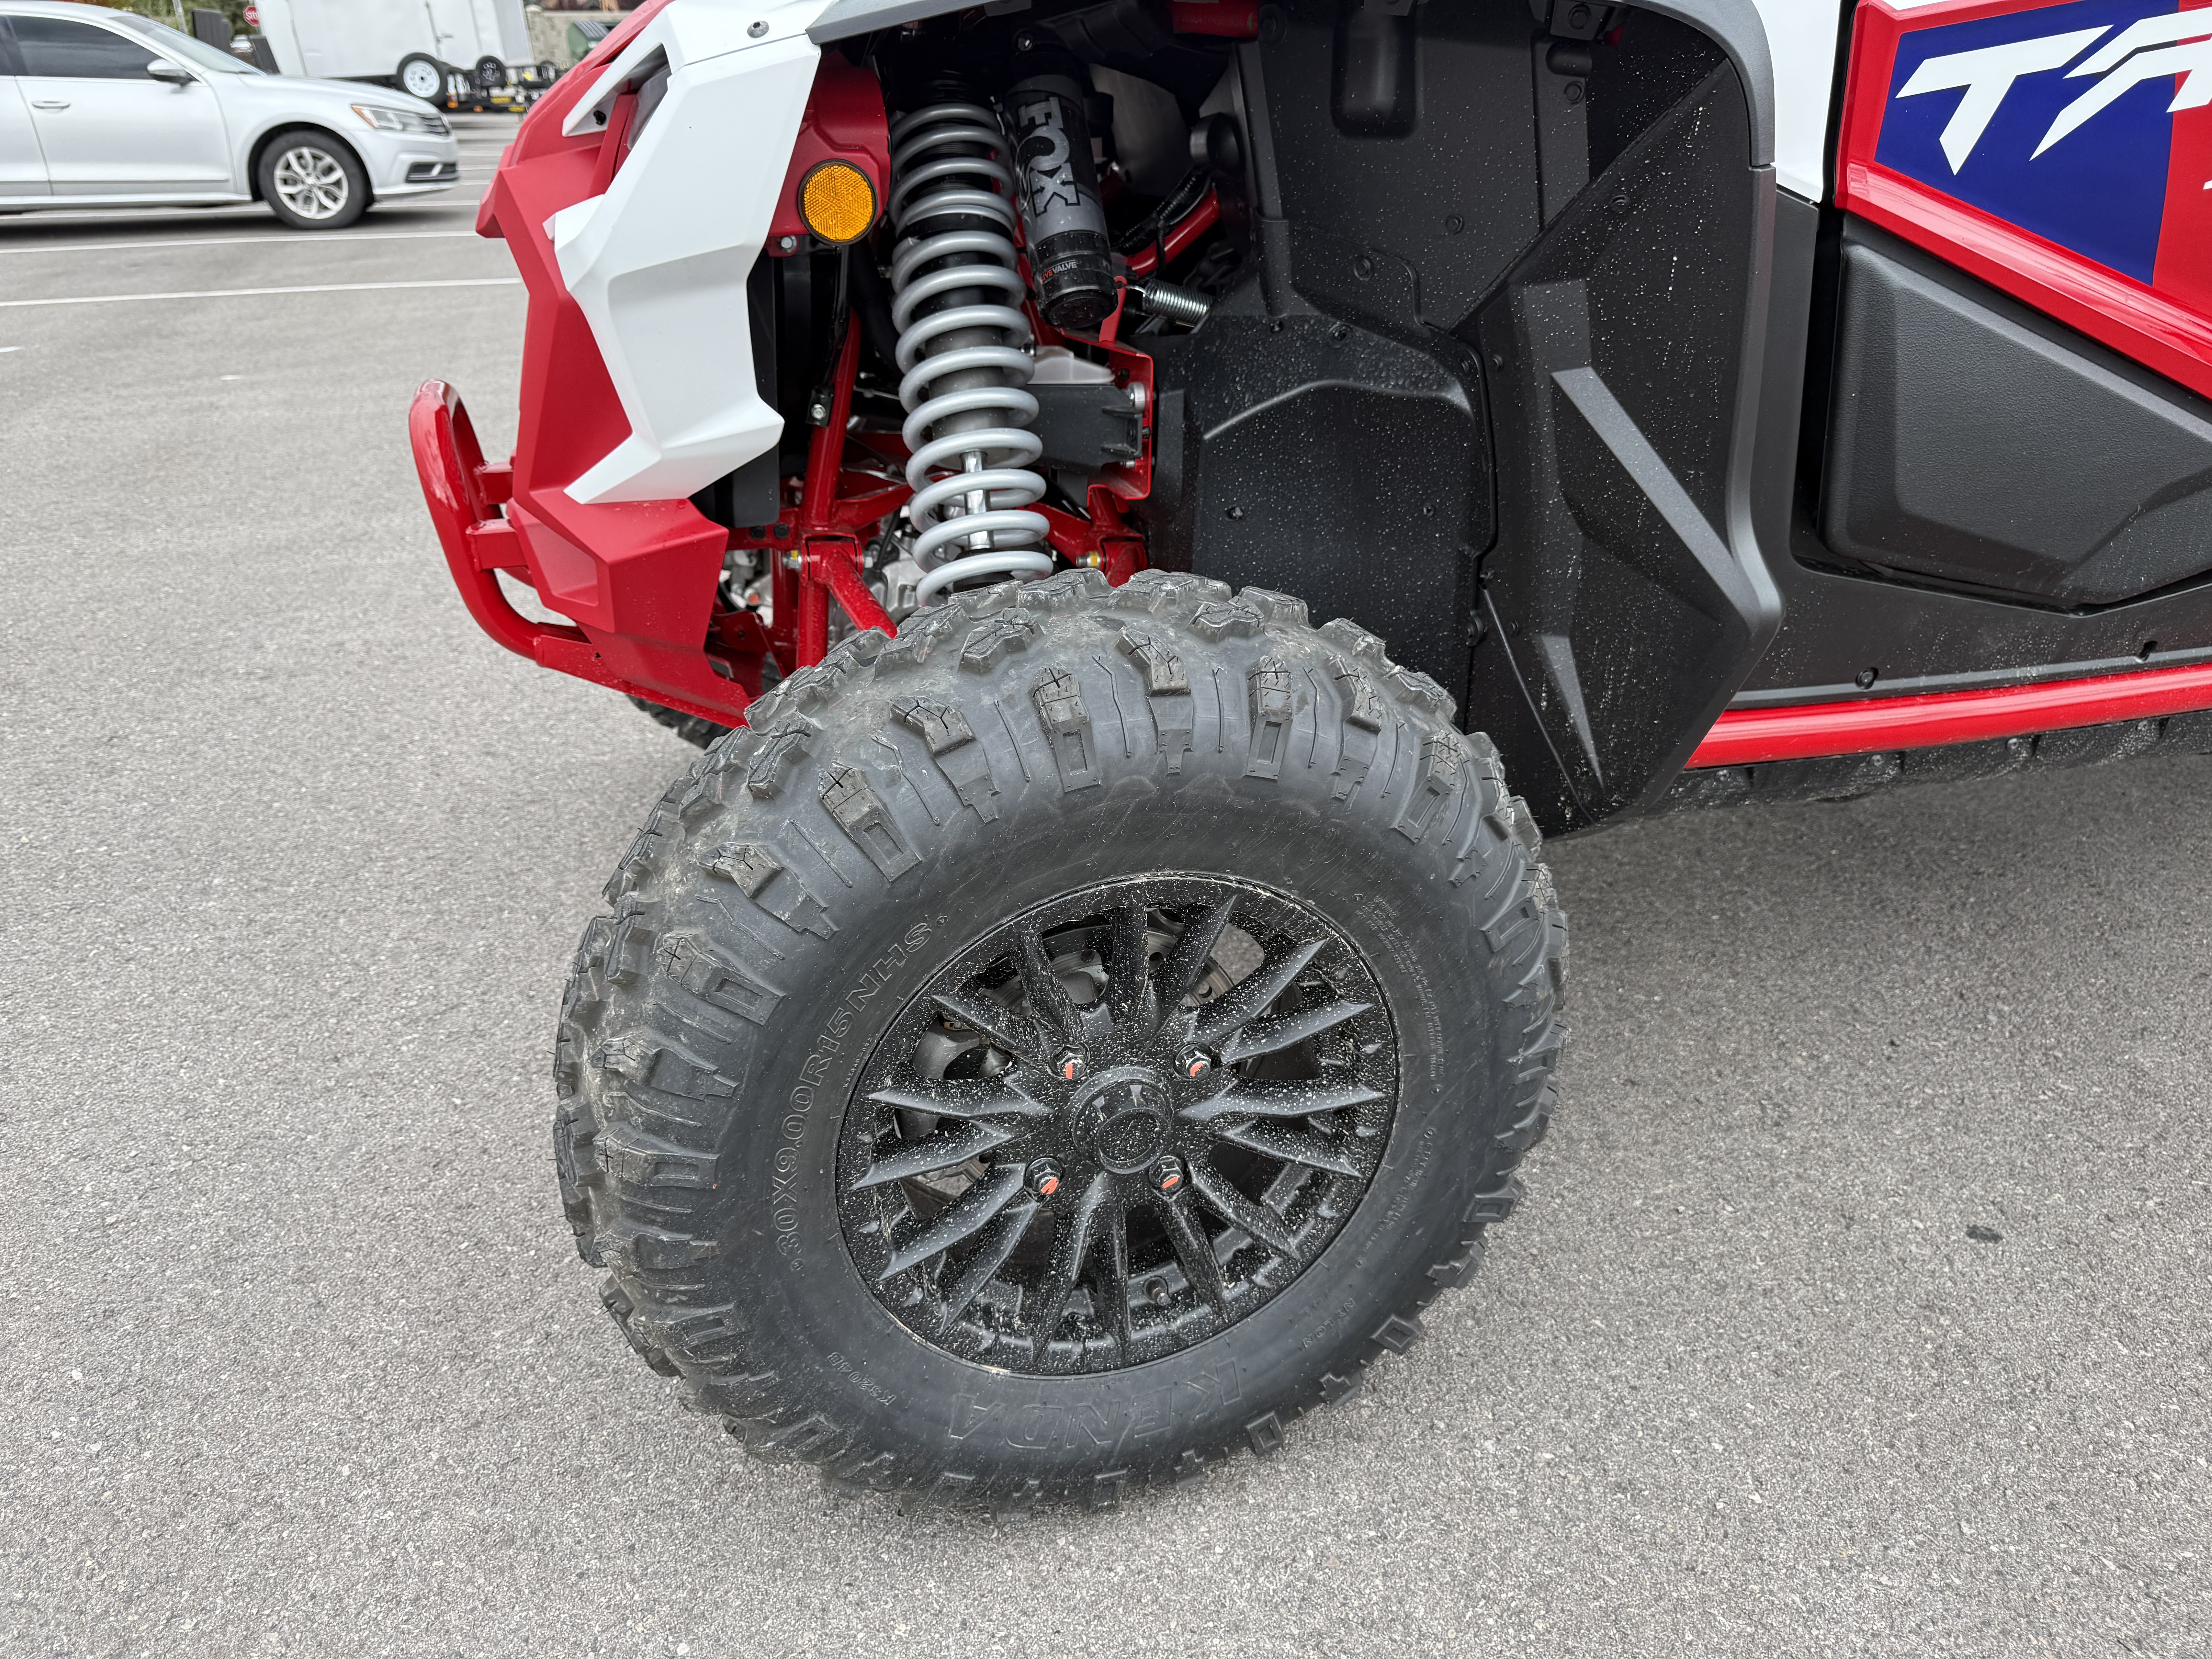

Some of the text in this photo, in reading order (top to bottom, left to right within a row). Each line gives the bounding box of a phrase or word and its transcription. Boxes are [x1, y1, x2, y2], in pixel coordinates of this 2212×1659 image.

[1018, 97, 1079, 215] FOX
[827, 1352, 896, 1405] K3204B
[948, 1360, 1240, 1449] KENDA
